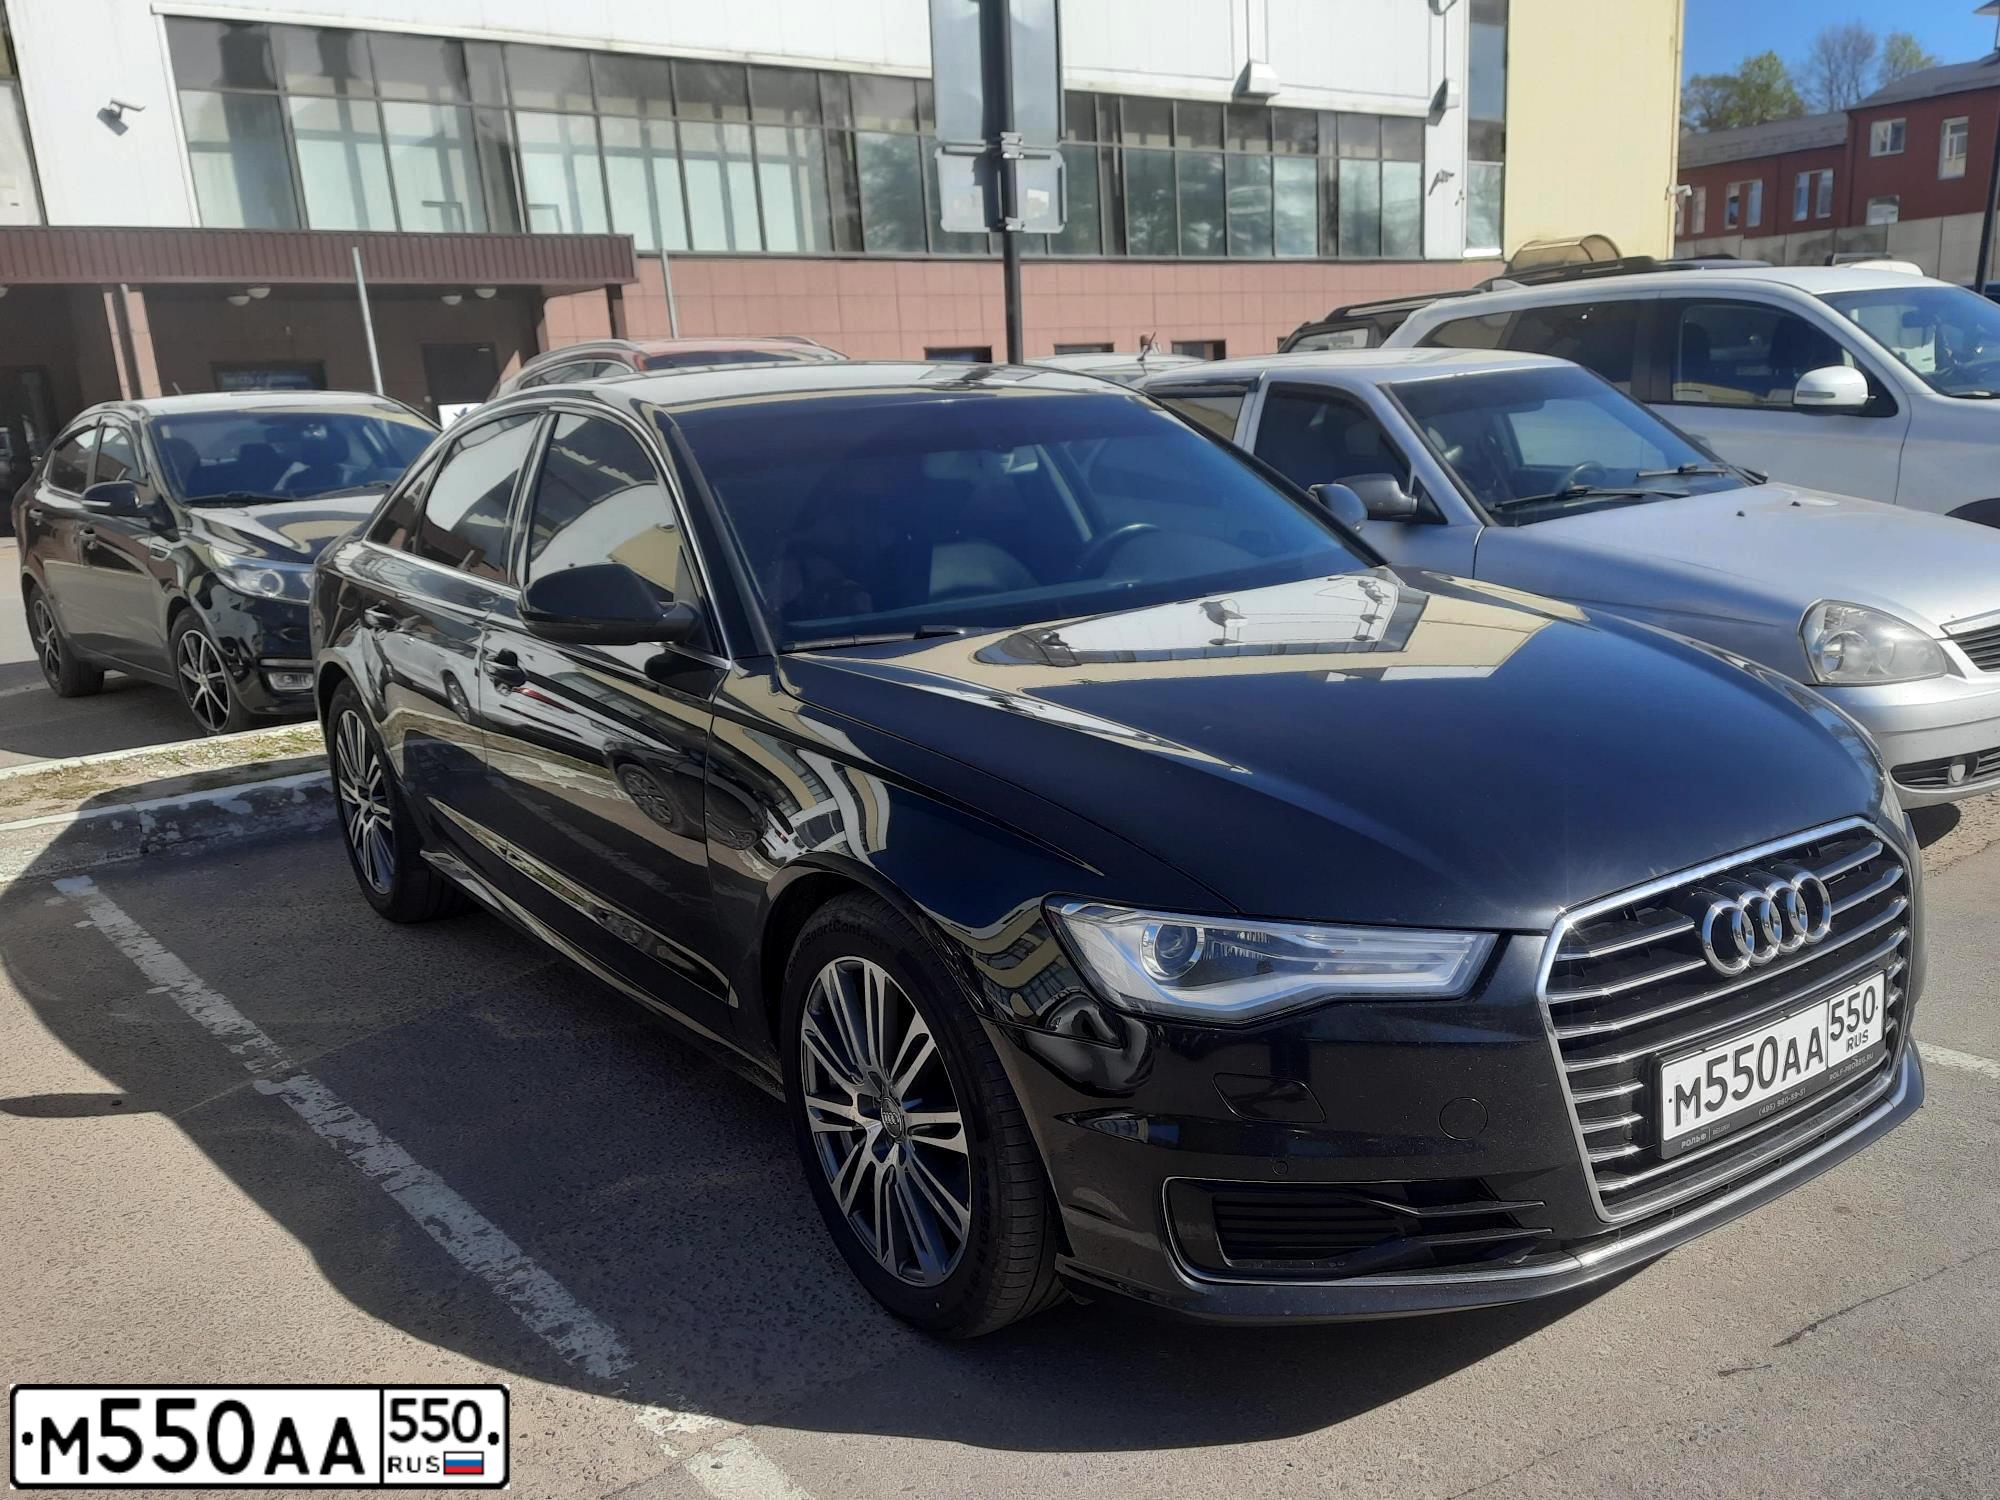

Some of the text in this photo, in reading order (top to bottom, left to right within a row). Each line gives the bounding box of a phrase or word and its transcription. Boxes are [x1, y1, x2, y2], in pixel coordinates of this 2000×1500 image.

[1674, 985, 1876, 1127] М550АА 550
[1846, 1029, 1869, 1053] RUS
